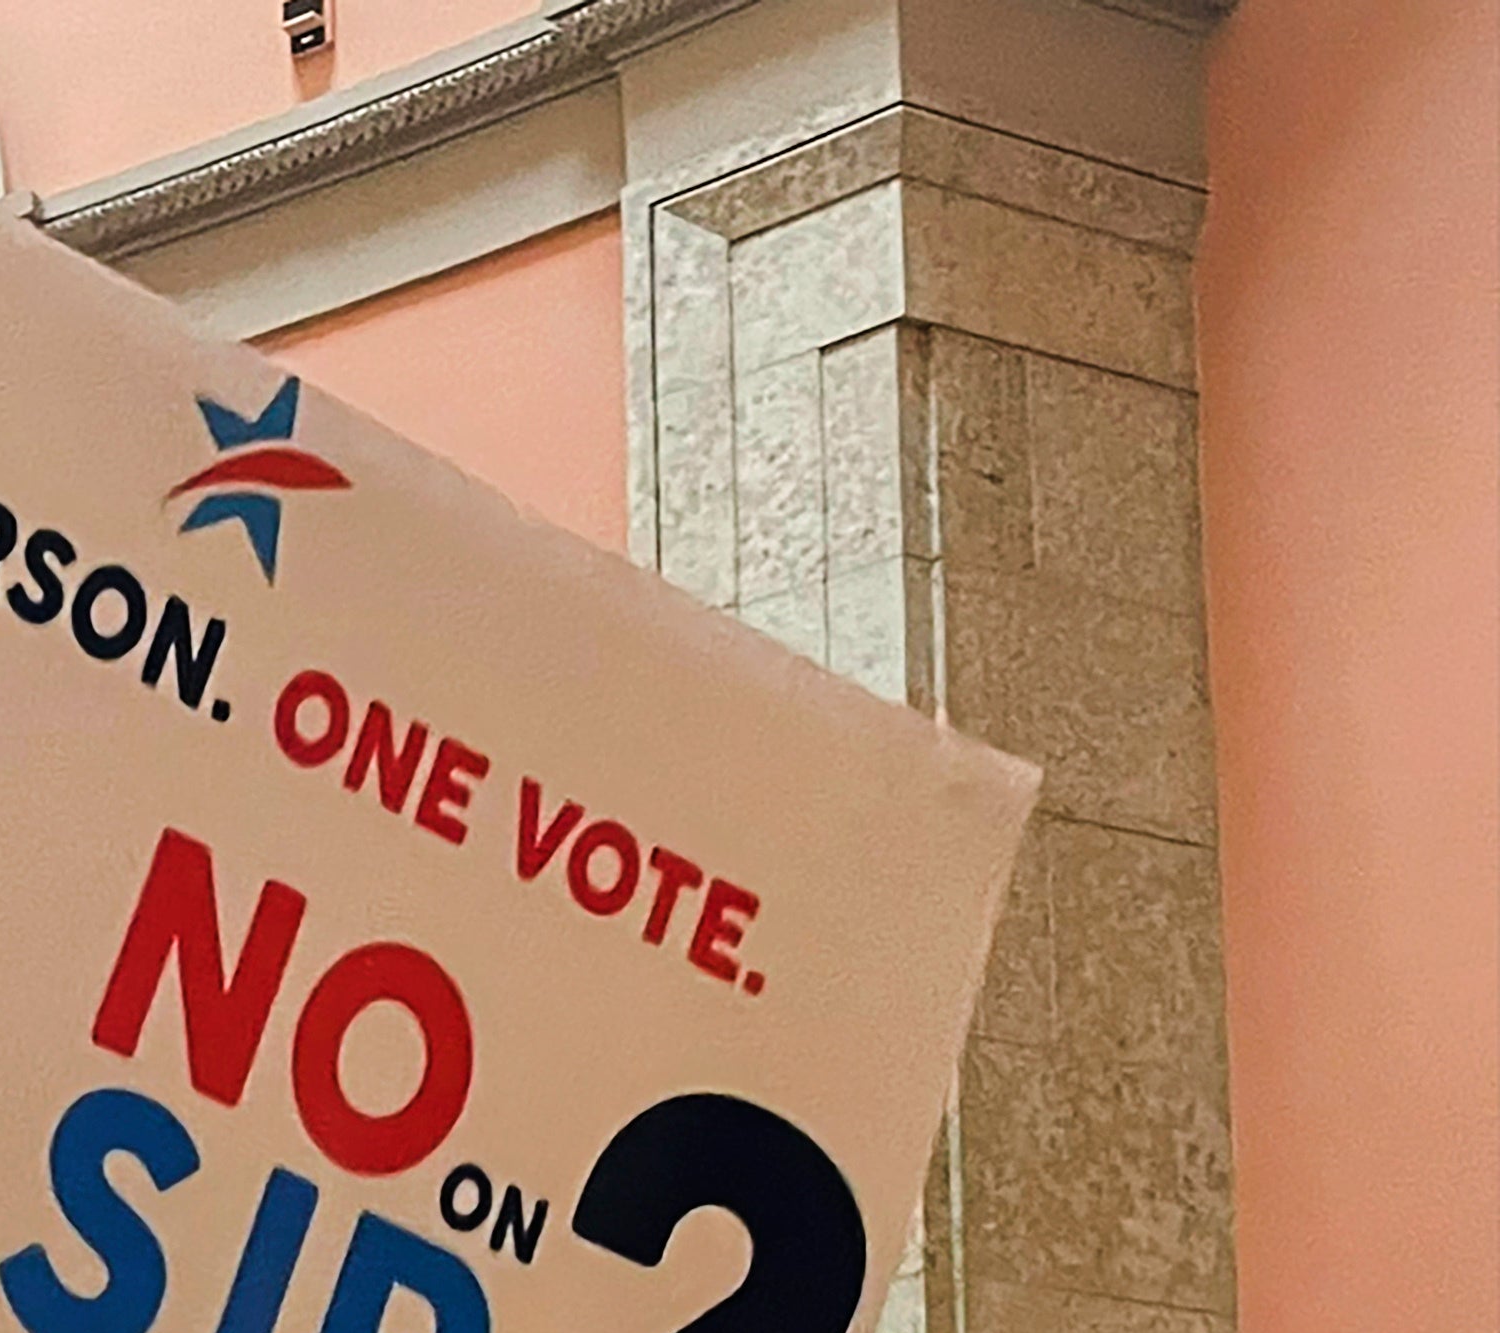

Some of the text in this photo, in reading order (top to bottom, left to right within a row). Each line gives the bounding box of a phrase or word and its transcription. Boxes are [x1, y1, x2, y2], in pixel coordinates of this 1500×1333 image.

[272, 669, 768, 993] ONE VOTE.
[90, 825, 550, 1266] NO ON
